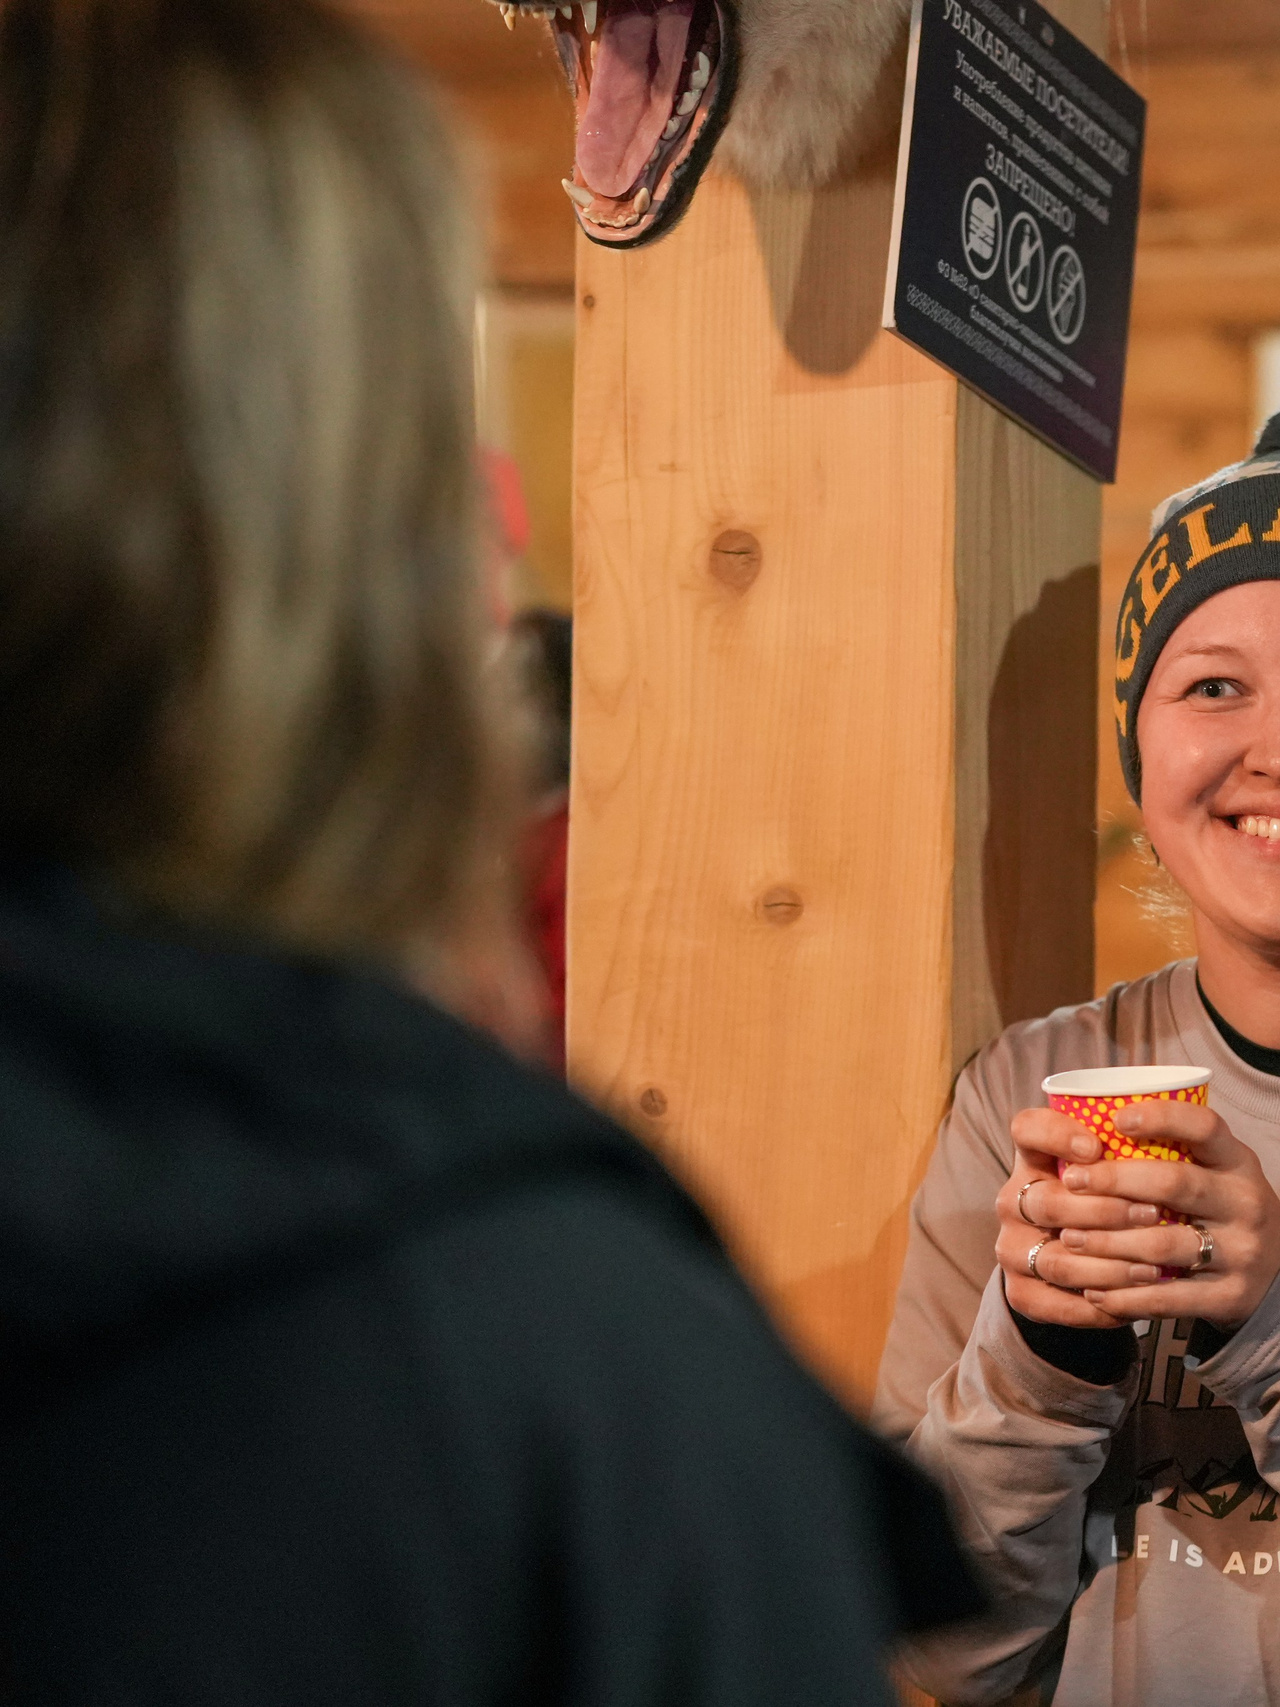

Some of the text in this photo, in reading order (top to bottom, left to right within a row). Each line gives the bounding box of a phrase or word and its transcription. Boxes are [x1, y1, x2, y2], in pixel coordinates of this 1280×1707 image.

[943, 0, 1035, 94] УВАЖАЕМЫЕ
[985, 143, 1075, 236] ЗАПРЕЩЕНО!
[1169, 1538, 1204, 1568] IS
